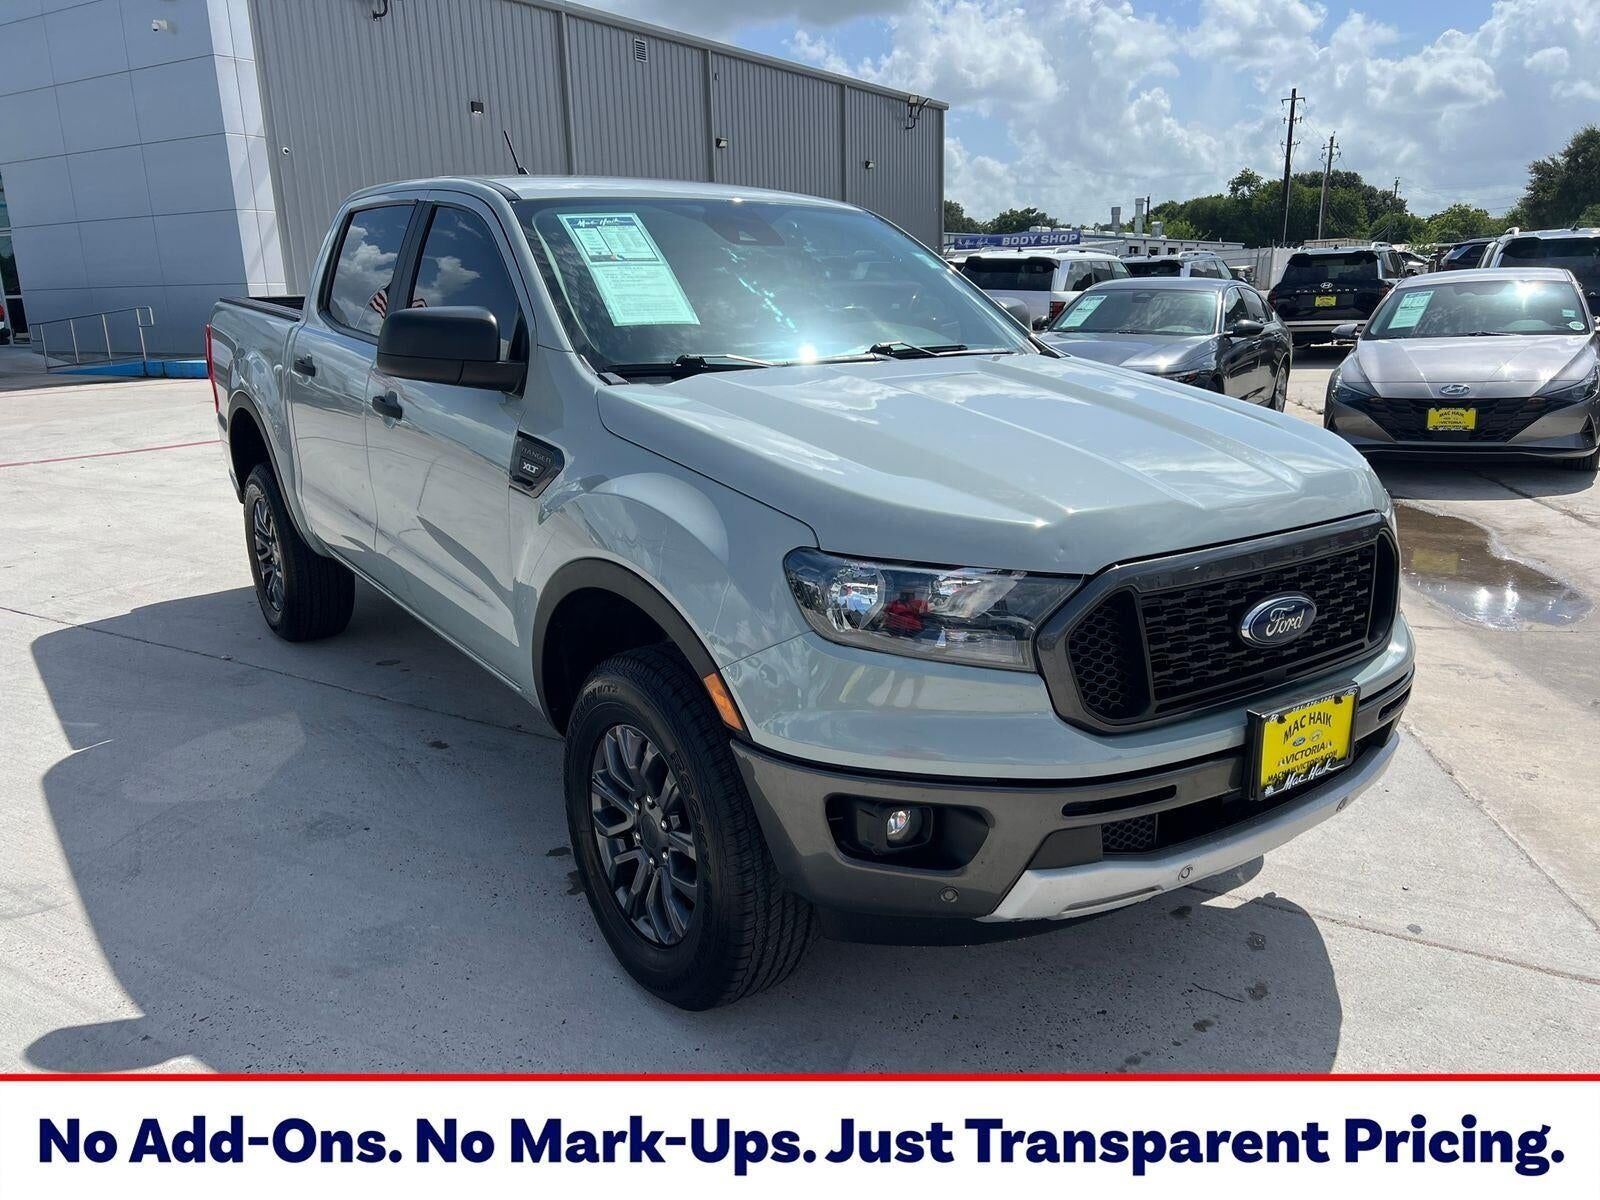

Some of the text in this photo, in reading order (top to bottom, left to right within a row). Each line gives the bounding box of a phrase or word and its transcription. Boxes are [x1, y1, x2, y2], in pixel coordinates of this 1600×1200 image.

[1002, 235, 1038, 246] BODY
[1040, 233, 1078, 244] SHOP
[522, 462, 539, 474] XLT
[1265, 605, 1305, 637] Ford
[1283, 711, 1333, 744] MAC HAIK
[1285, 743, 1327, 765] VICTORIA
